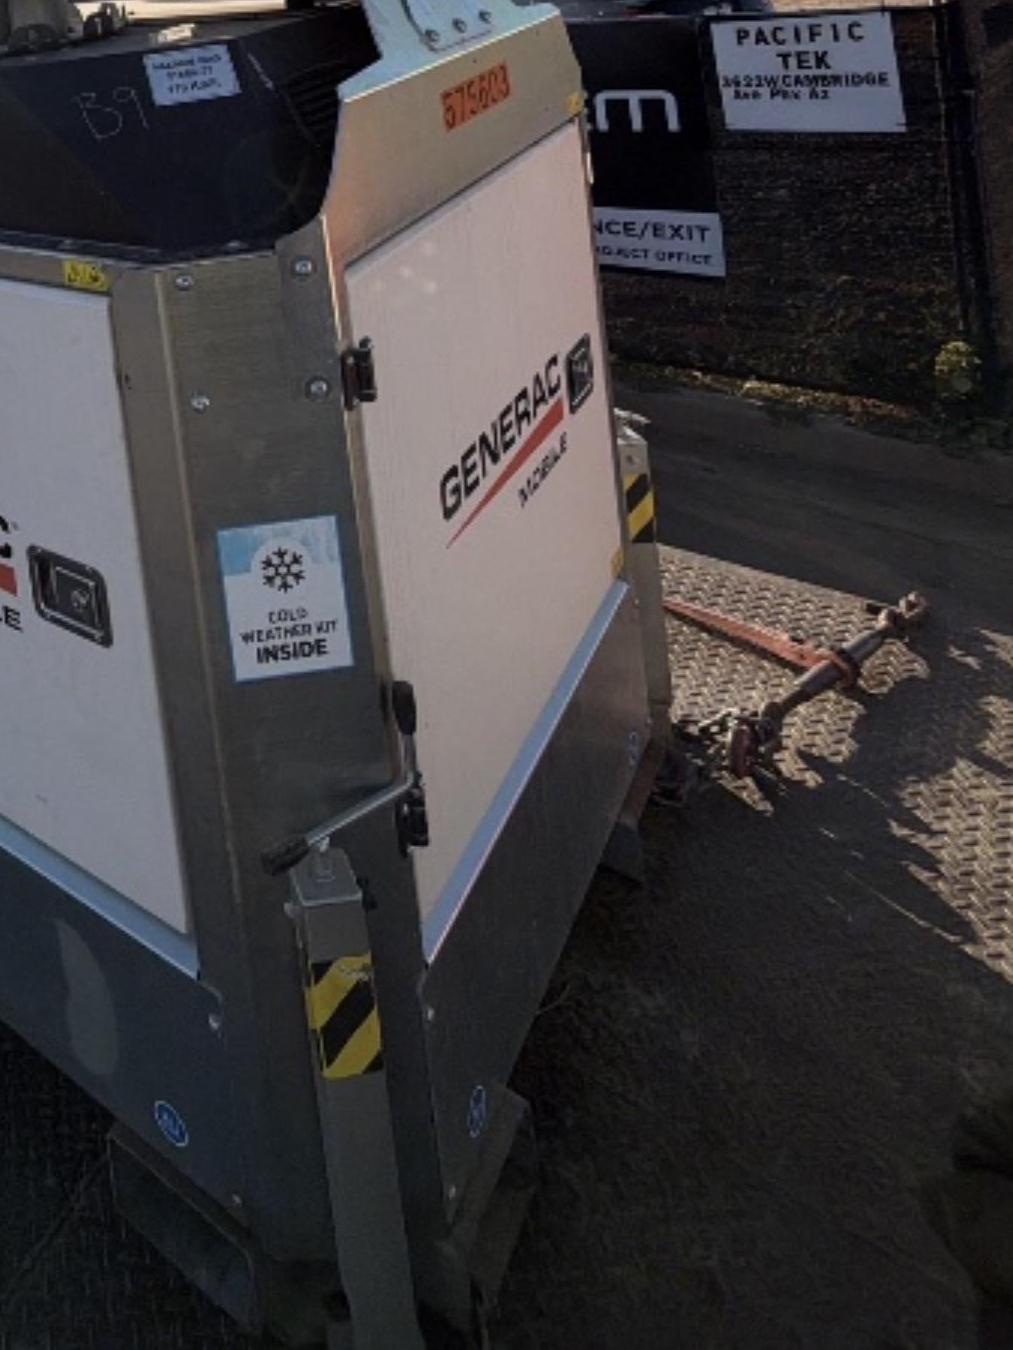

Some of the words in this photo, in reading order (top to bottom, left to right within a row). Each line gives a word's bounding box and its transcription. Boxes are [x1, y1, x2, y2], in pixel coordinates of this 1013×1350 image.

[736, 21, 865, 45] PACIFIC
[776, 50, 831, 69] TEK
[440, 354, 561, 522] GENERAC
[268, 606, 308, 625] COLD
[240, 623, 312, 645] WEATHER
[256, 638, 328, 664] INSIDE
